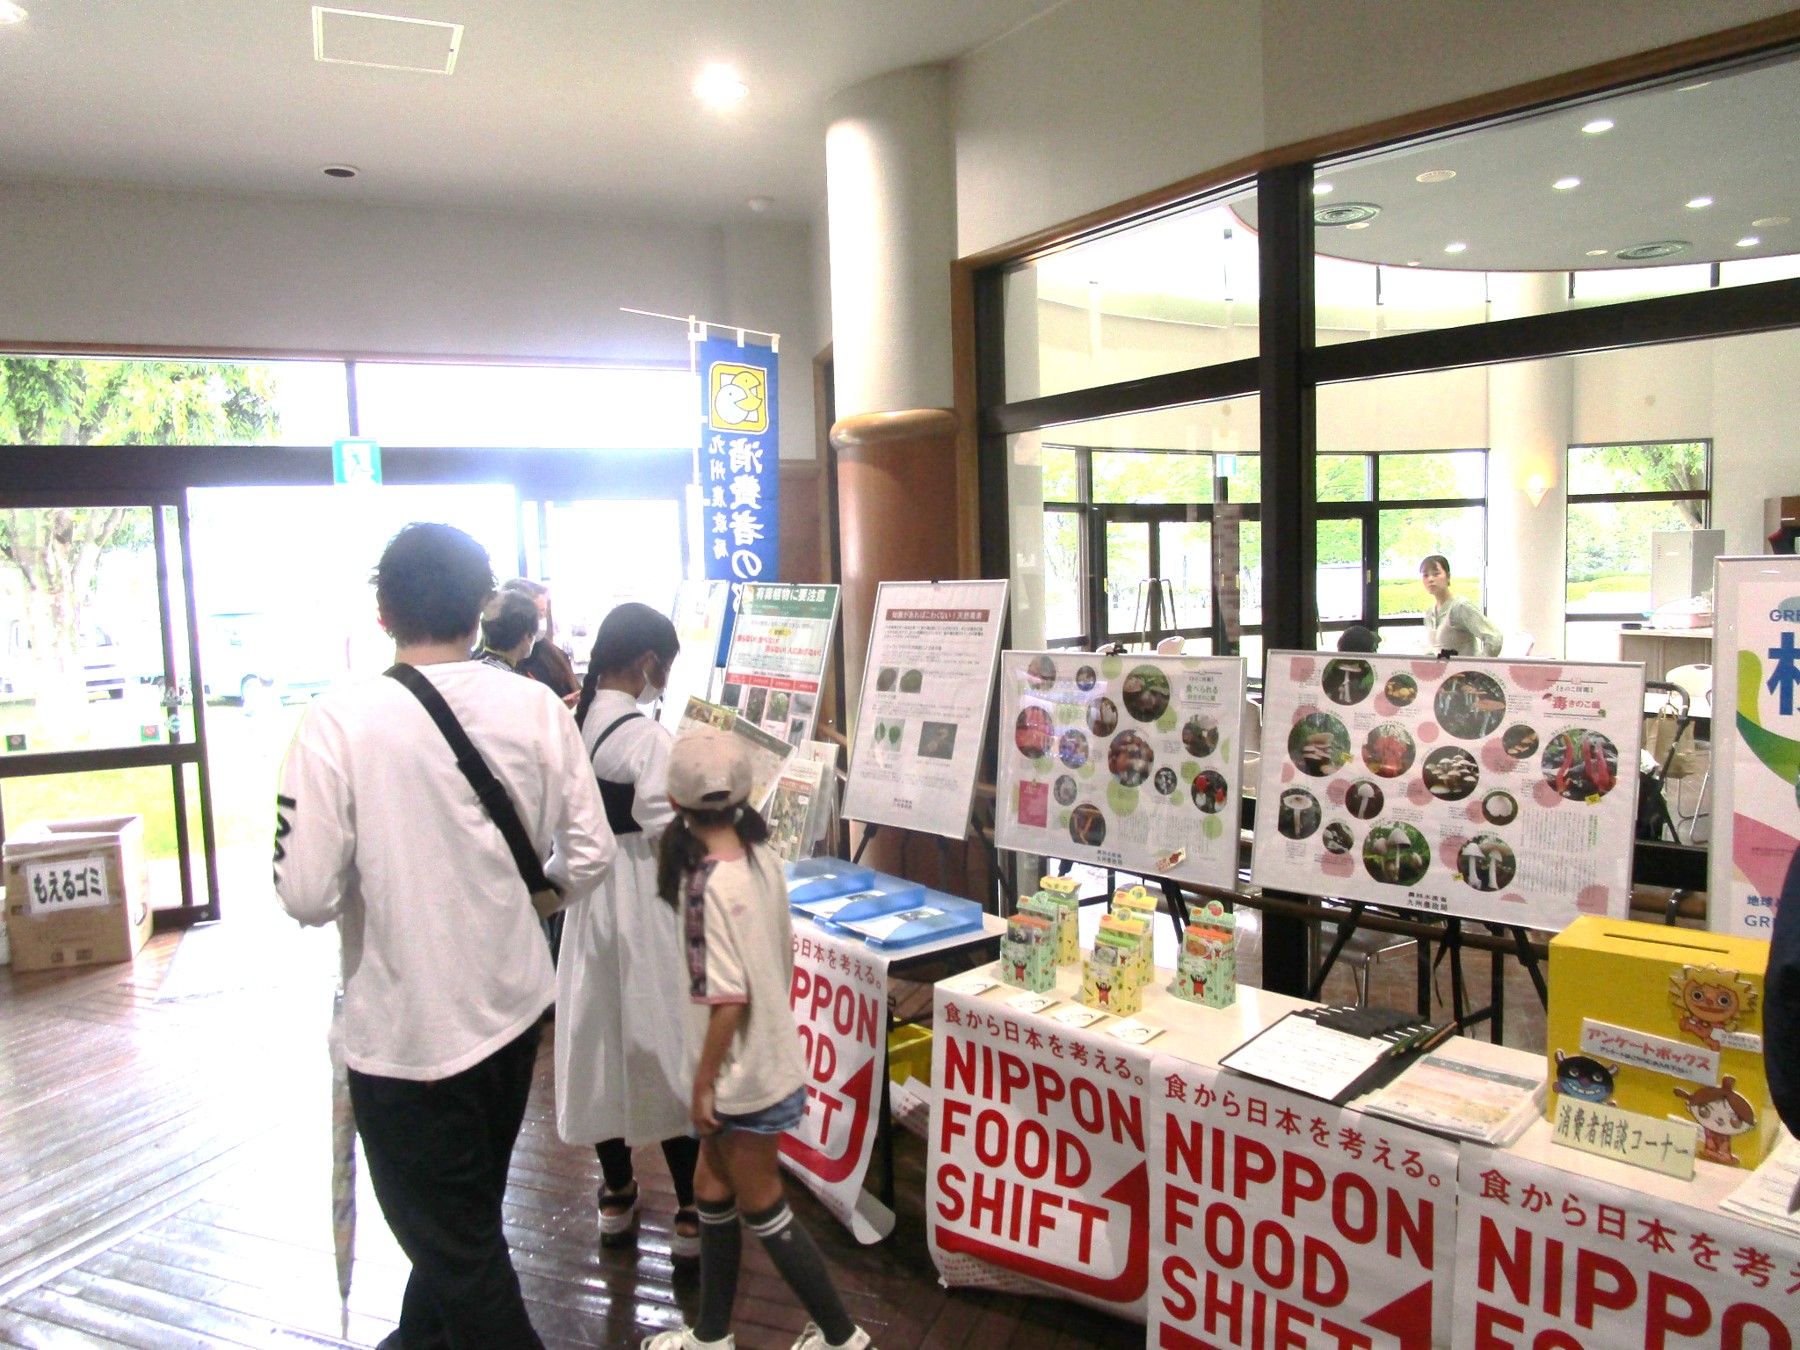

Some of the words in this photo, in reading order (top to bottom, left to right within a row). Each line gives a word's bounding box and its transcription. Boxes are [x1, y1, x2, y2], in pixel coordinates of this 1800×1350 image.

[756, 587, 827, 602] 有毒植物に要注意
[34, 867, 102, 904] もえるゴミ
[1744, 915, 1777, 929] GR
[944, 1001, 1144, 1086] 食から日本を考える。
[1586, 1028, 1711, 1072] アンケートボックス
[944, 1035, 1147, 1154] NIPPON
[1164, 1073, 1442, 1188] 食から日本を考える。
[1557, 1104, 1689, 1162] 消費者相談コーナー
[940, 1098, 1092, 1189] FOOD
[935, 1163, 1110, 1265] SHIFT
[1166, 1111, 1434, 1272] NIPPON
[1164, 1183, 1350, 1309] FOOD
